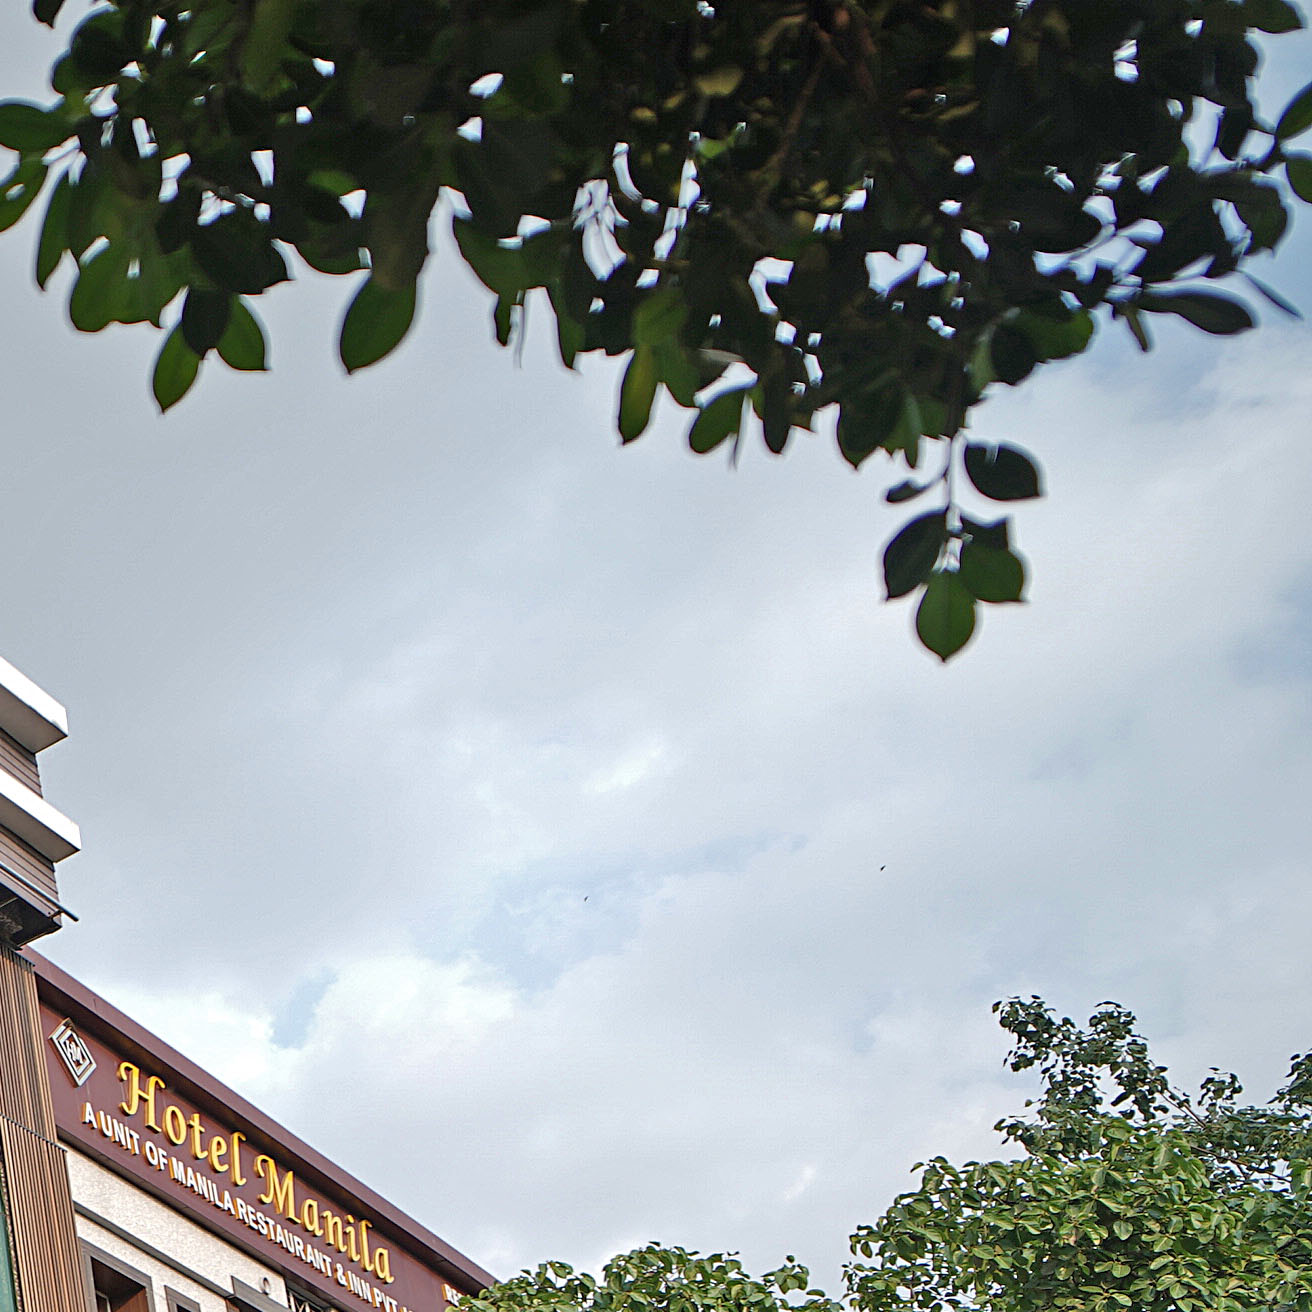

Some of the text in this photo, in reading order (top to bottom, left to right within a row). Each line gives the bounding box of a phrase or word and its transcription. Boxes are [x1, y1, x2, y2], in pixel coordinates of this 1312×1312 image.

[82, 1102, 97, 1130] A
[97, 1110, 140, 1155] UNIT
[144, 1141, 168, 1172] OF
[169, 1157, 236, 1216] MANILA
[235, 1197, 333, 1278] RESTAURANT
[334, 1263, 346, 1287] &
[346, 1270, 374, 1304] INN
[118, 1061, 395, 1284] Hotel Manila
